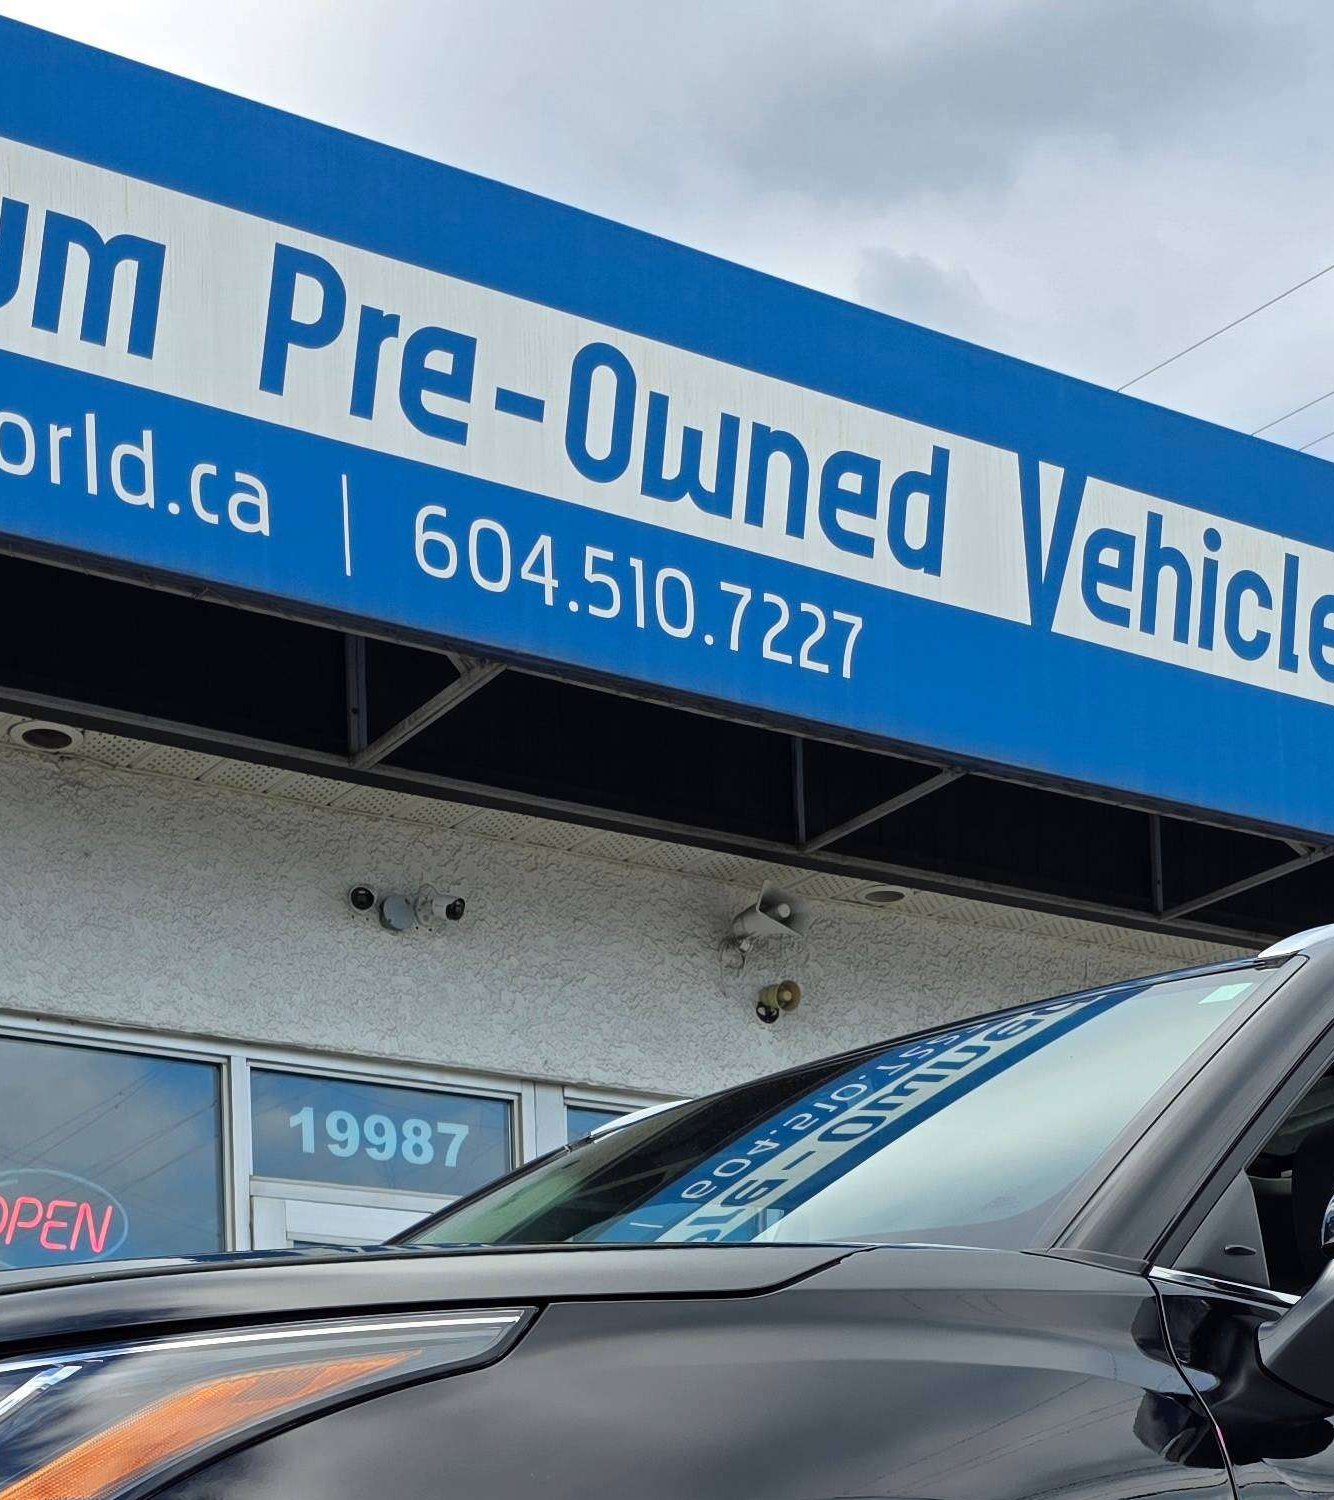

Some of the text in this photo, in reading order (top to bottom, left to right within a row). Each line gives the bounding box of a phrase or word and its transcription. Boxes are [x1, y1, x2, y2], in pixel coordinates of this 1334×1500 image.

[259, 242, 950, 577] Pre-Owned
[414, 503, 863, 681] 604.510.7227
[289, 1106, 469, 1168] 19987
